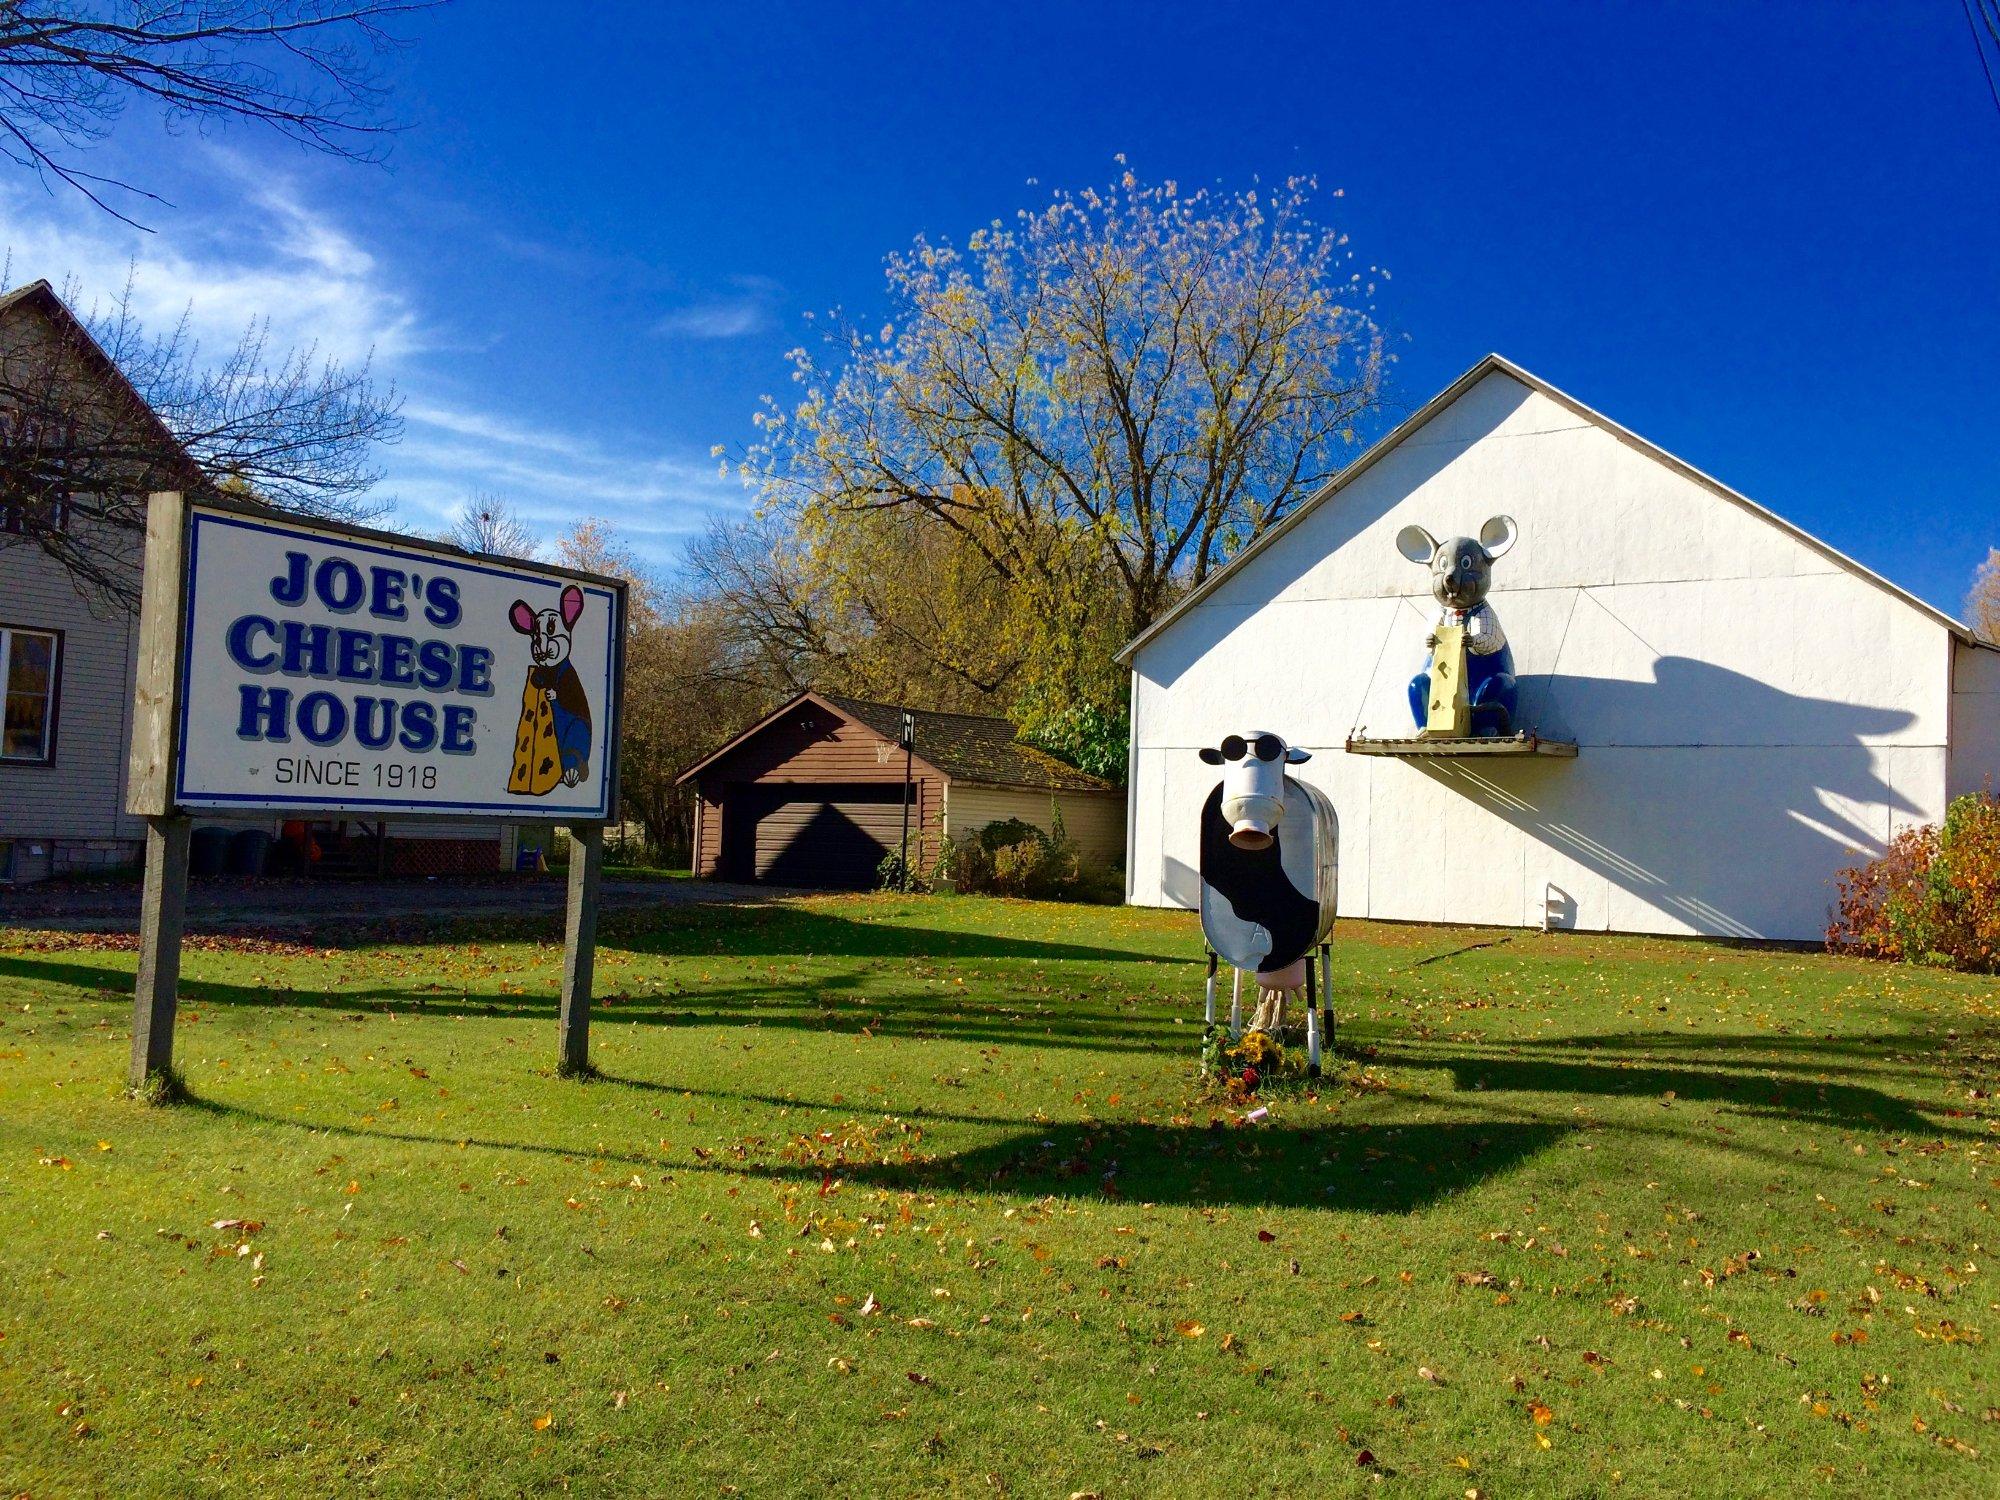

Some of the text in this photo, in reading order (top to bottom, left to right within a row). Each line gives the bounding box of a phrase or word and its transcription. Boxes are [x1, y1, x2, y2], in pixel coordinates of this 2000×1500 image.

[270, 551, 462, 629] JOE'S
[226, 615, 495, 697] CHEESE
[237, 684, 477, 756] HOUSE
[275, 757, 437, 789] SINCE 1918
